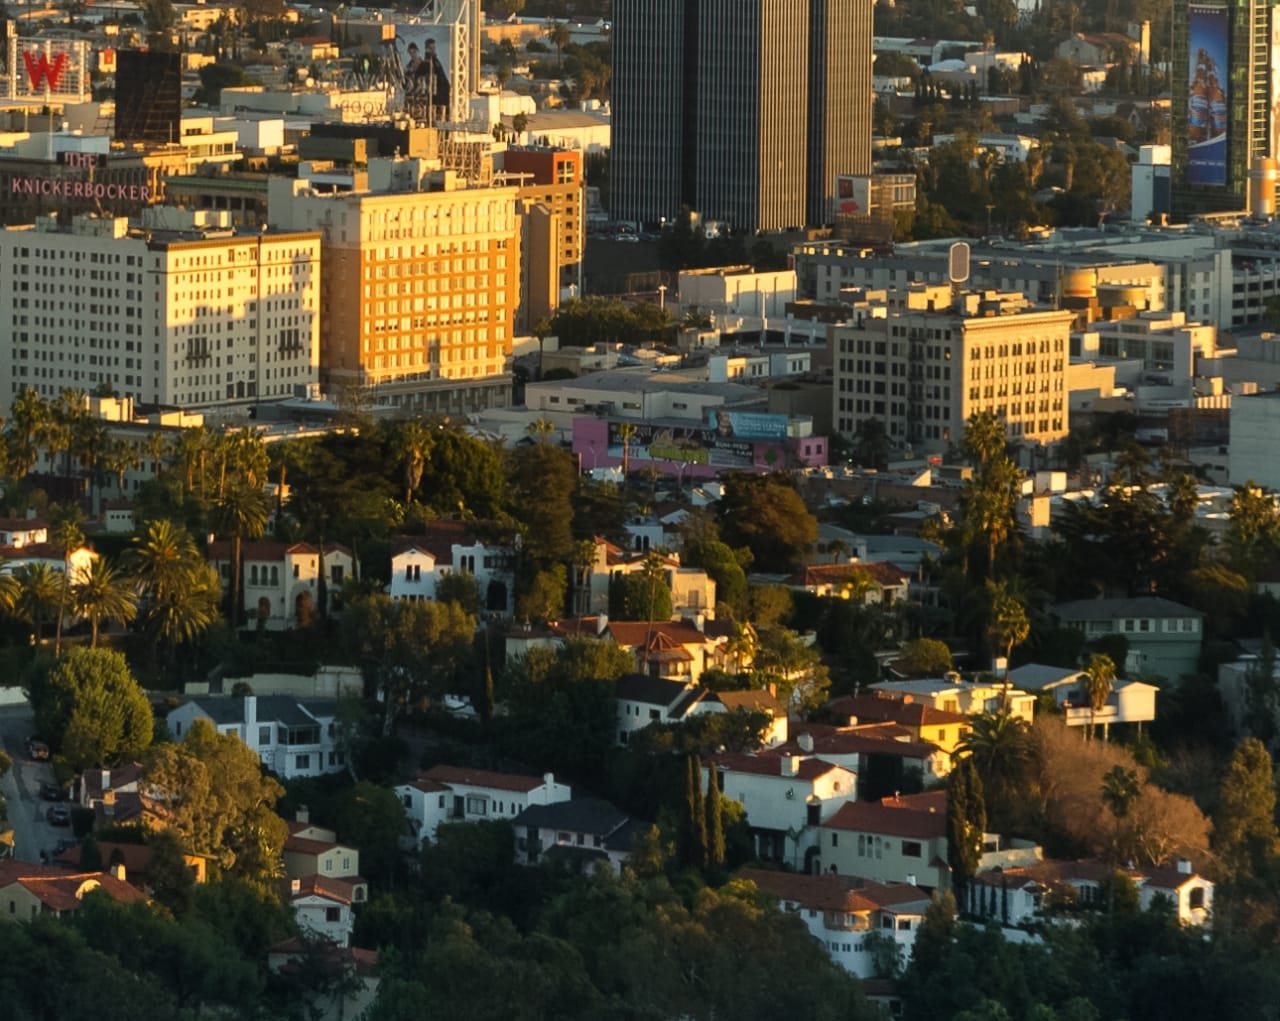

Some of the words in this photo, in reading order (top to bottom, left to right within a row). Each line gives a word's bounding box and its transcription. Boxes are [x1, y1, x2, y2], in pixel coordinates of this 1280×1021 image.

[22, 51, 71, 92] W
[65, 152, 96, 168] THE
[12, 177, 149, 200] KNICKERBOCKER
